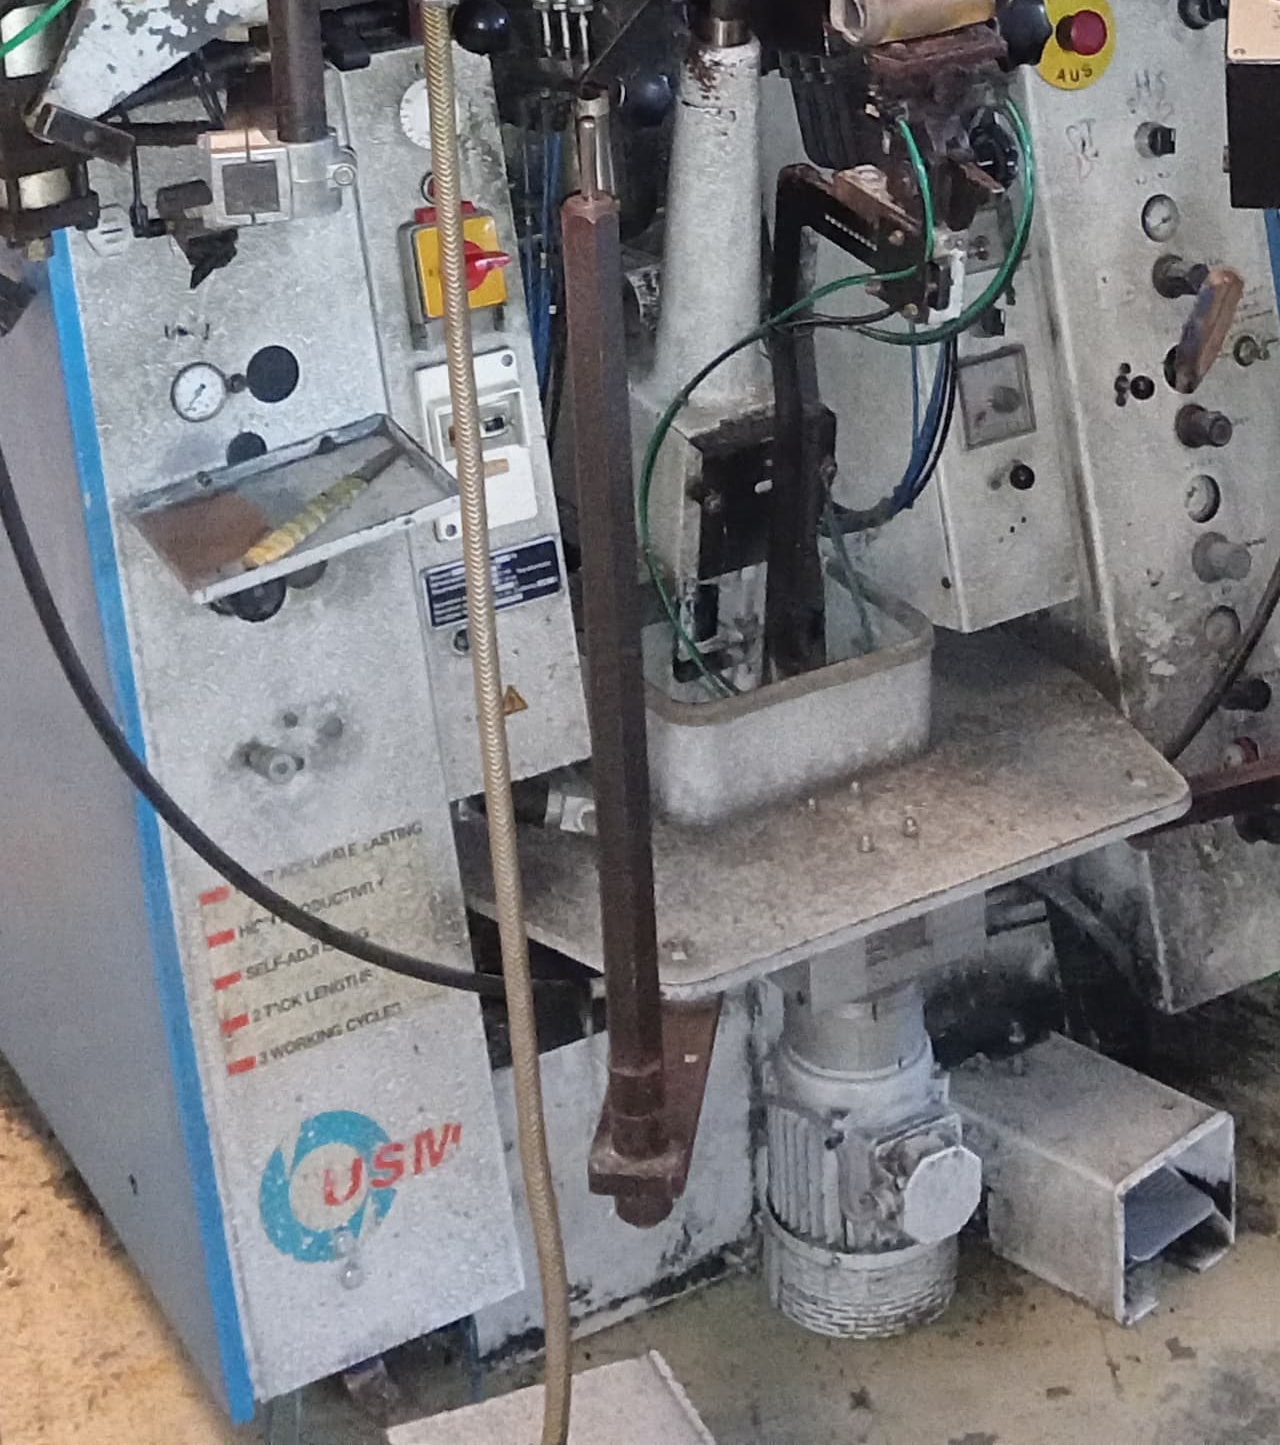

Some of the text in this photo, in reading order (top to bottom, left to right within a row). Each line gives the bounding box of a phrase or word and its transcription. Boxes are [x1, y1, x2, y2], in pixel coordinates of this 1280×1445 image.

[1056, 64, 1093, 83] AUS
[252, 1008, 262, 1024] 2
[270, 1023, 344, 1060] WORKING
